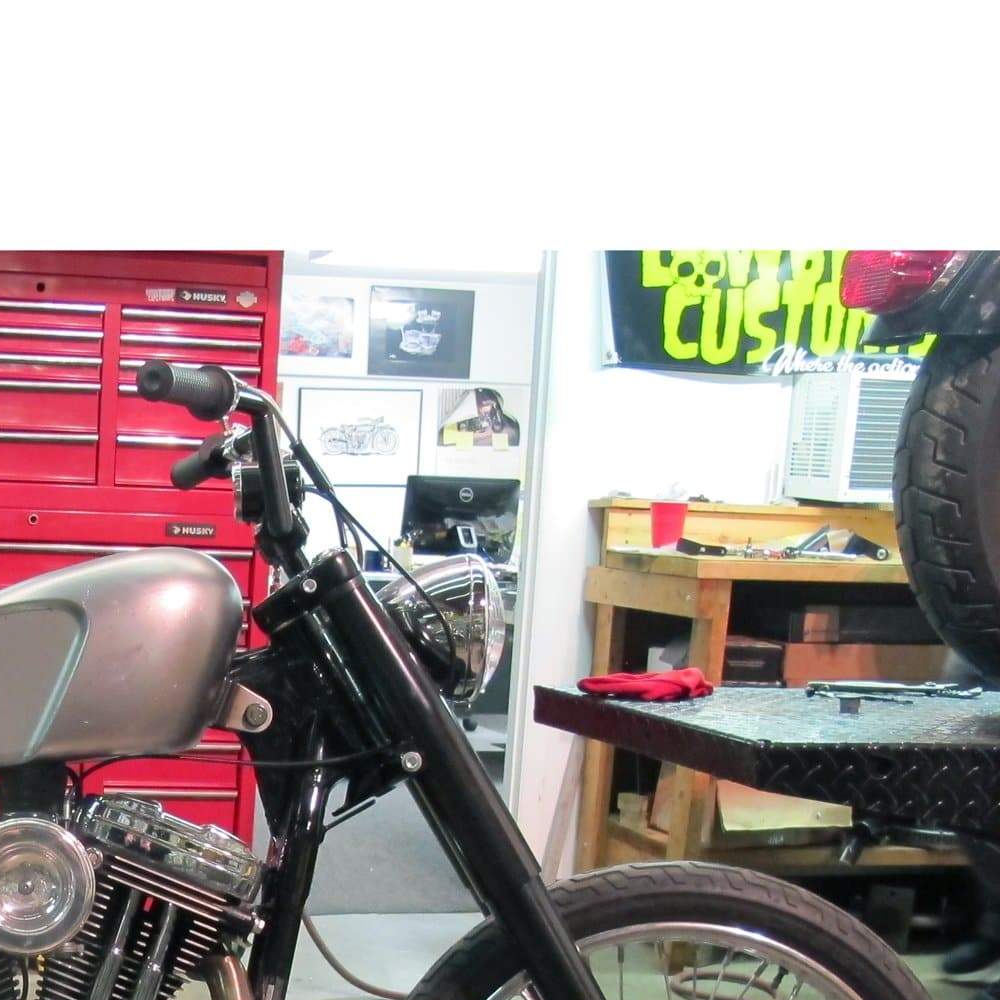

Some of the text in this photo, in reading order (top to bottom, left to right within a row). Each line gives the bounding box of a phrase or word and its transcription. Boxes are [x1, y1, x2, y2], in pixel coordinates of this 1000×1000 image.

[192, 292, 227, 303] HUSKY
[663, 279, 938, 366] CUSTO
[182, 527, 215, 536] HUSKY
